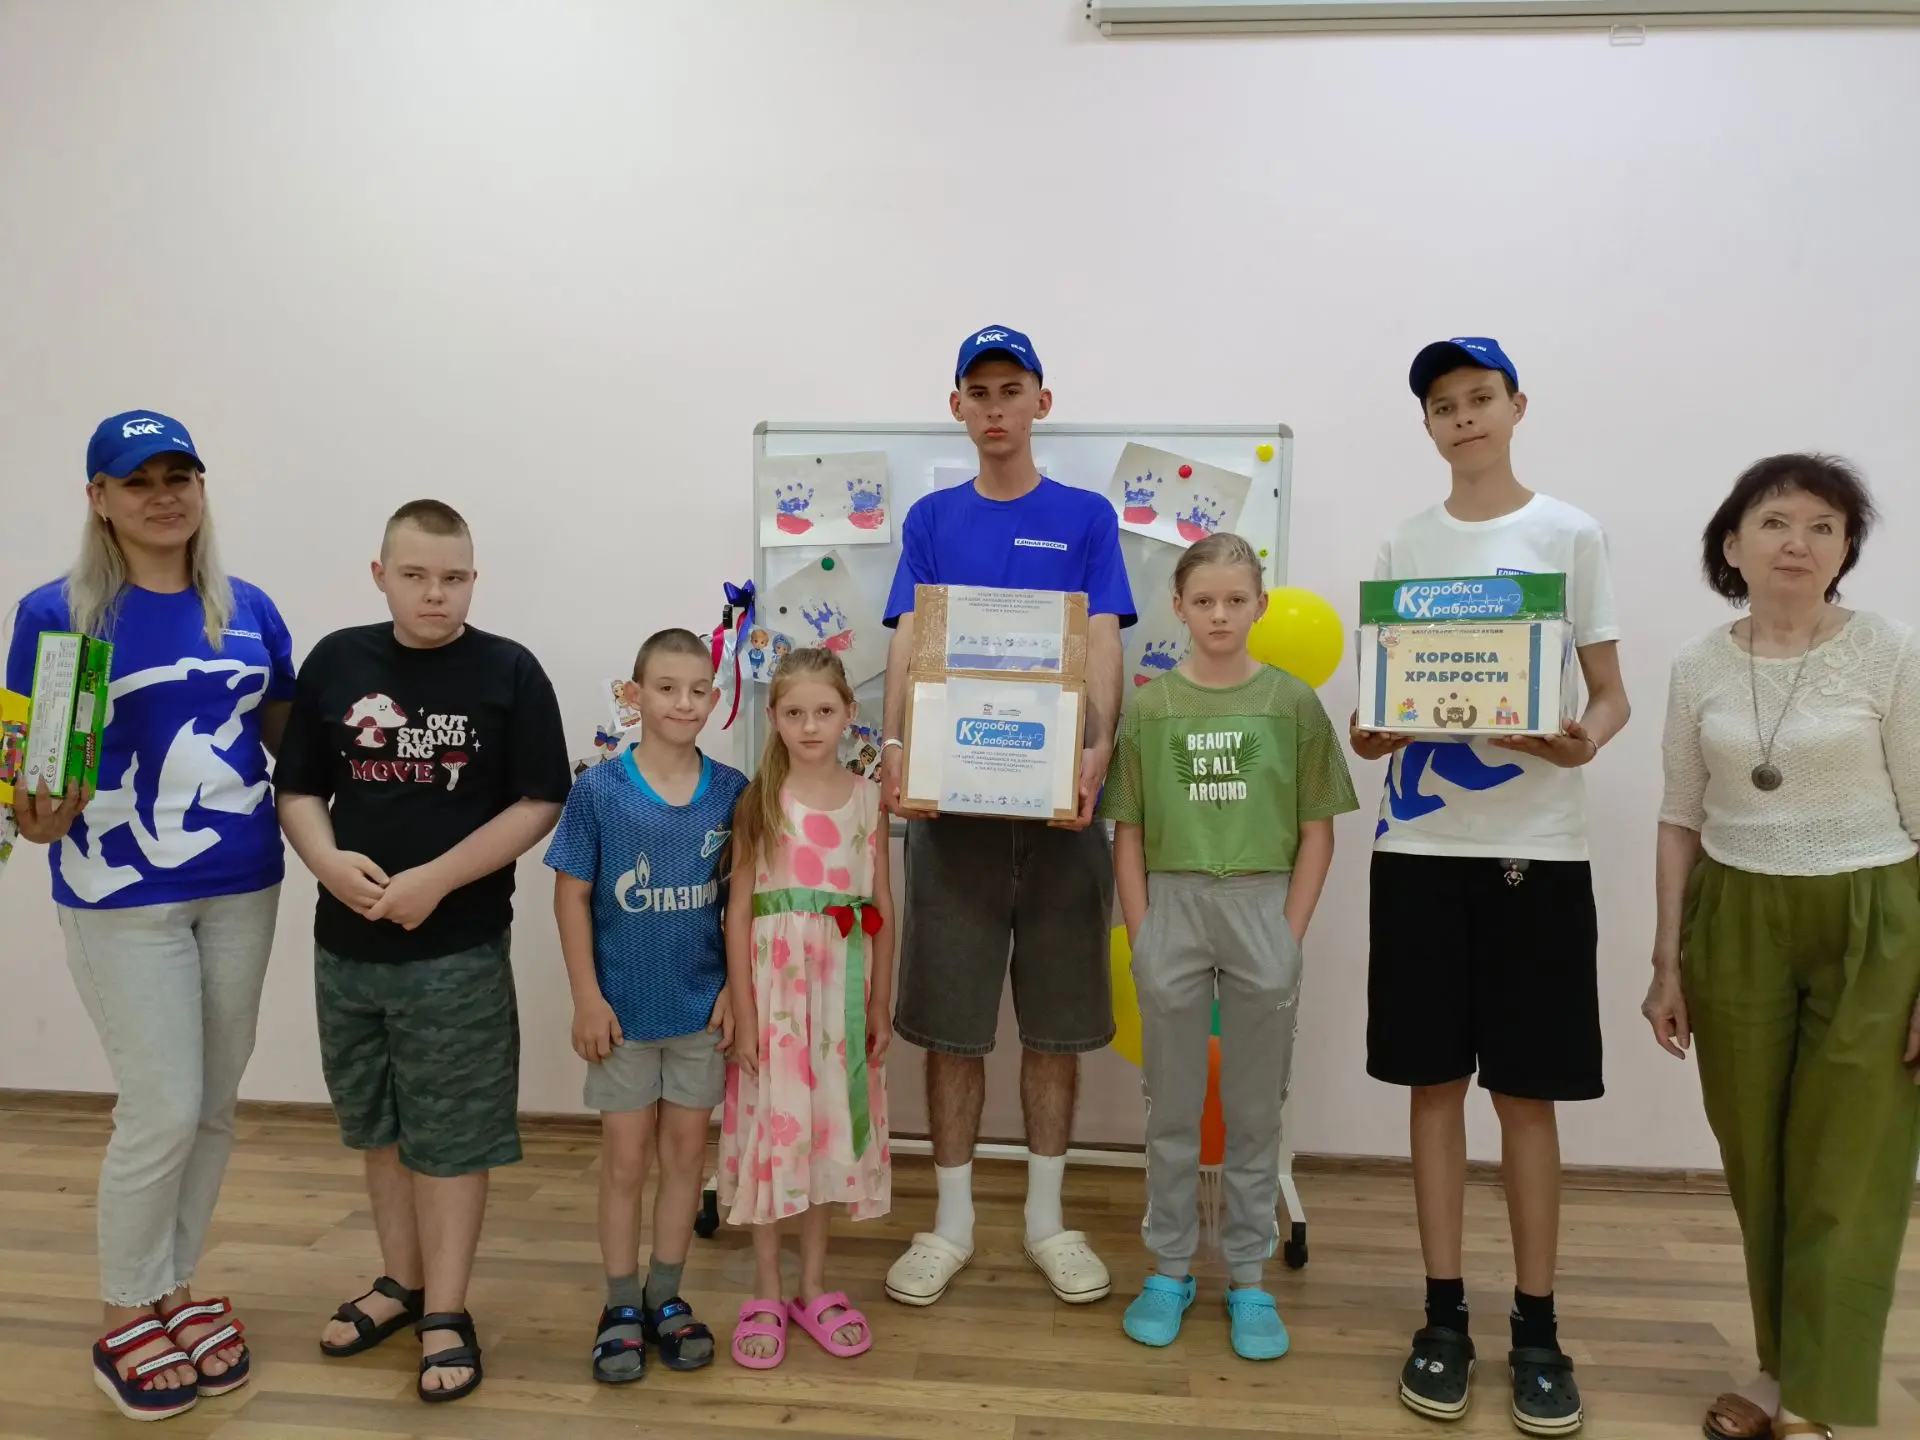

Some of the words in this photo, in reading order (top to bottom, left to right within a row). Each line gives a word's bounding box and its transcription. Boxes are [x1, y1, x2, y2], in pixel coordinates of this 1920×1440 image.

[1398, 582, 1483, 613] Коробка
[1415, 598, 1504, 618] Храбрости
[1415, 652, 1499, 664] КОРОБКА
[1404, 671, 1509, 682] ХРАБРОСТИ
[426, 714, 468, 731] OUT
[959, 720, 1019, 740] Коробка
[396, 727, 466, 746] STAND
[972, 731, 1032, 747] Храбрости
[1187, 731, 1243, 751] BEAUTY
[396, 742, 435, 759] ING
[349, 760, 435, 782] MOVE
[1193, 757, 1207, 776] IS
[1213, 756, 1240, 775] ALL
[1189, 781, 1247, 801] AROUND
